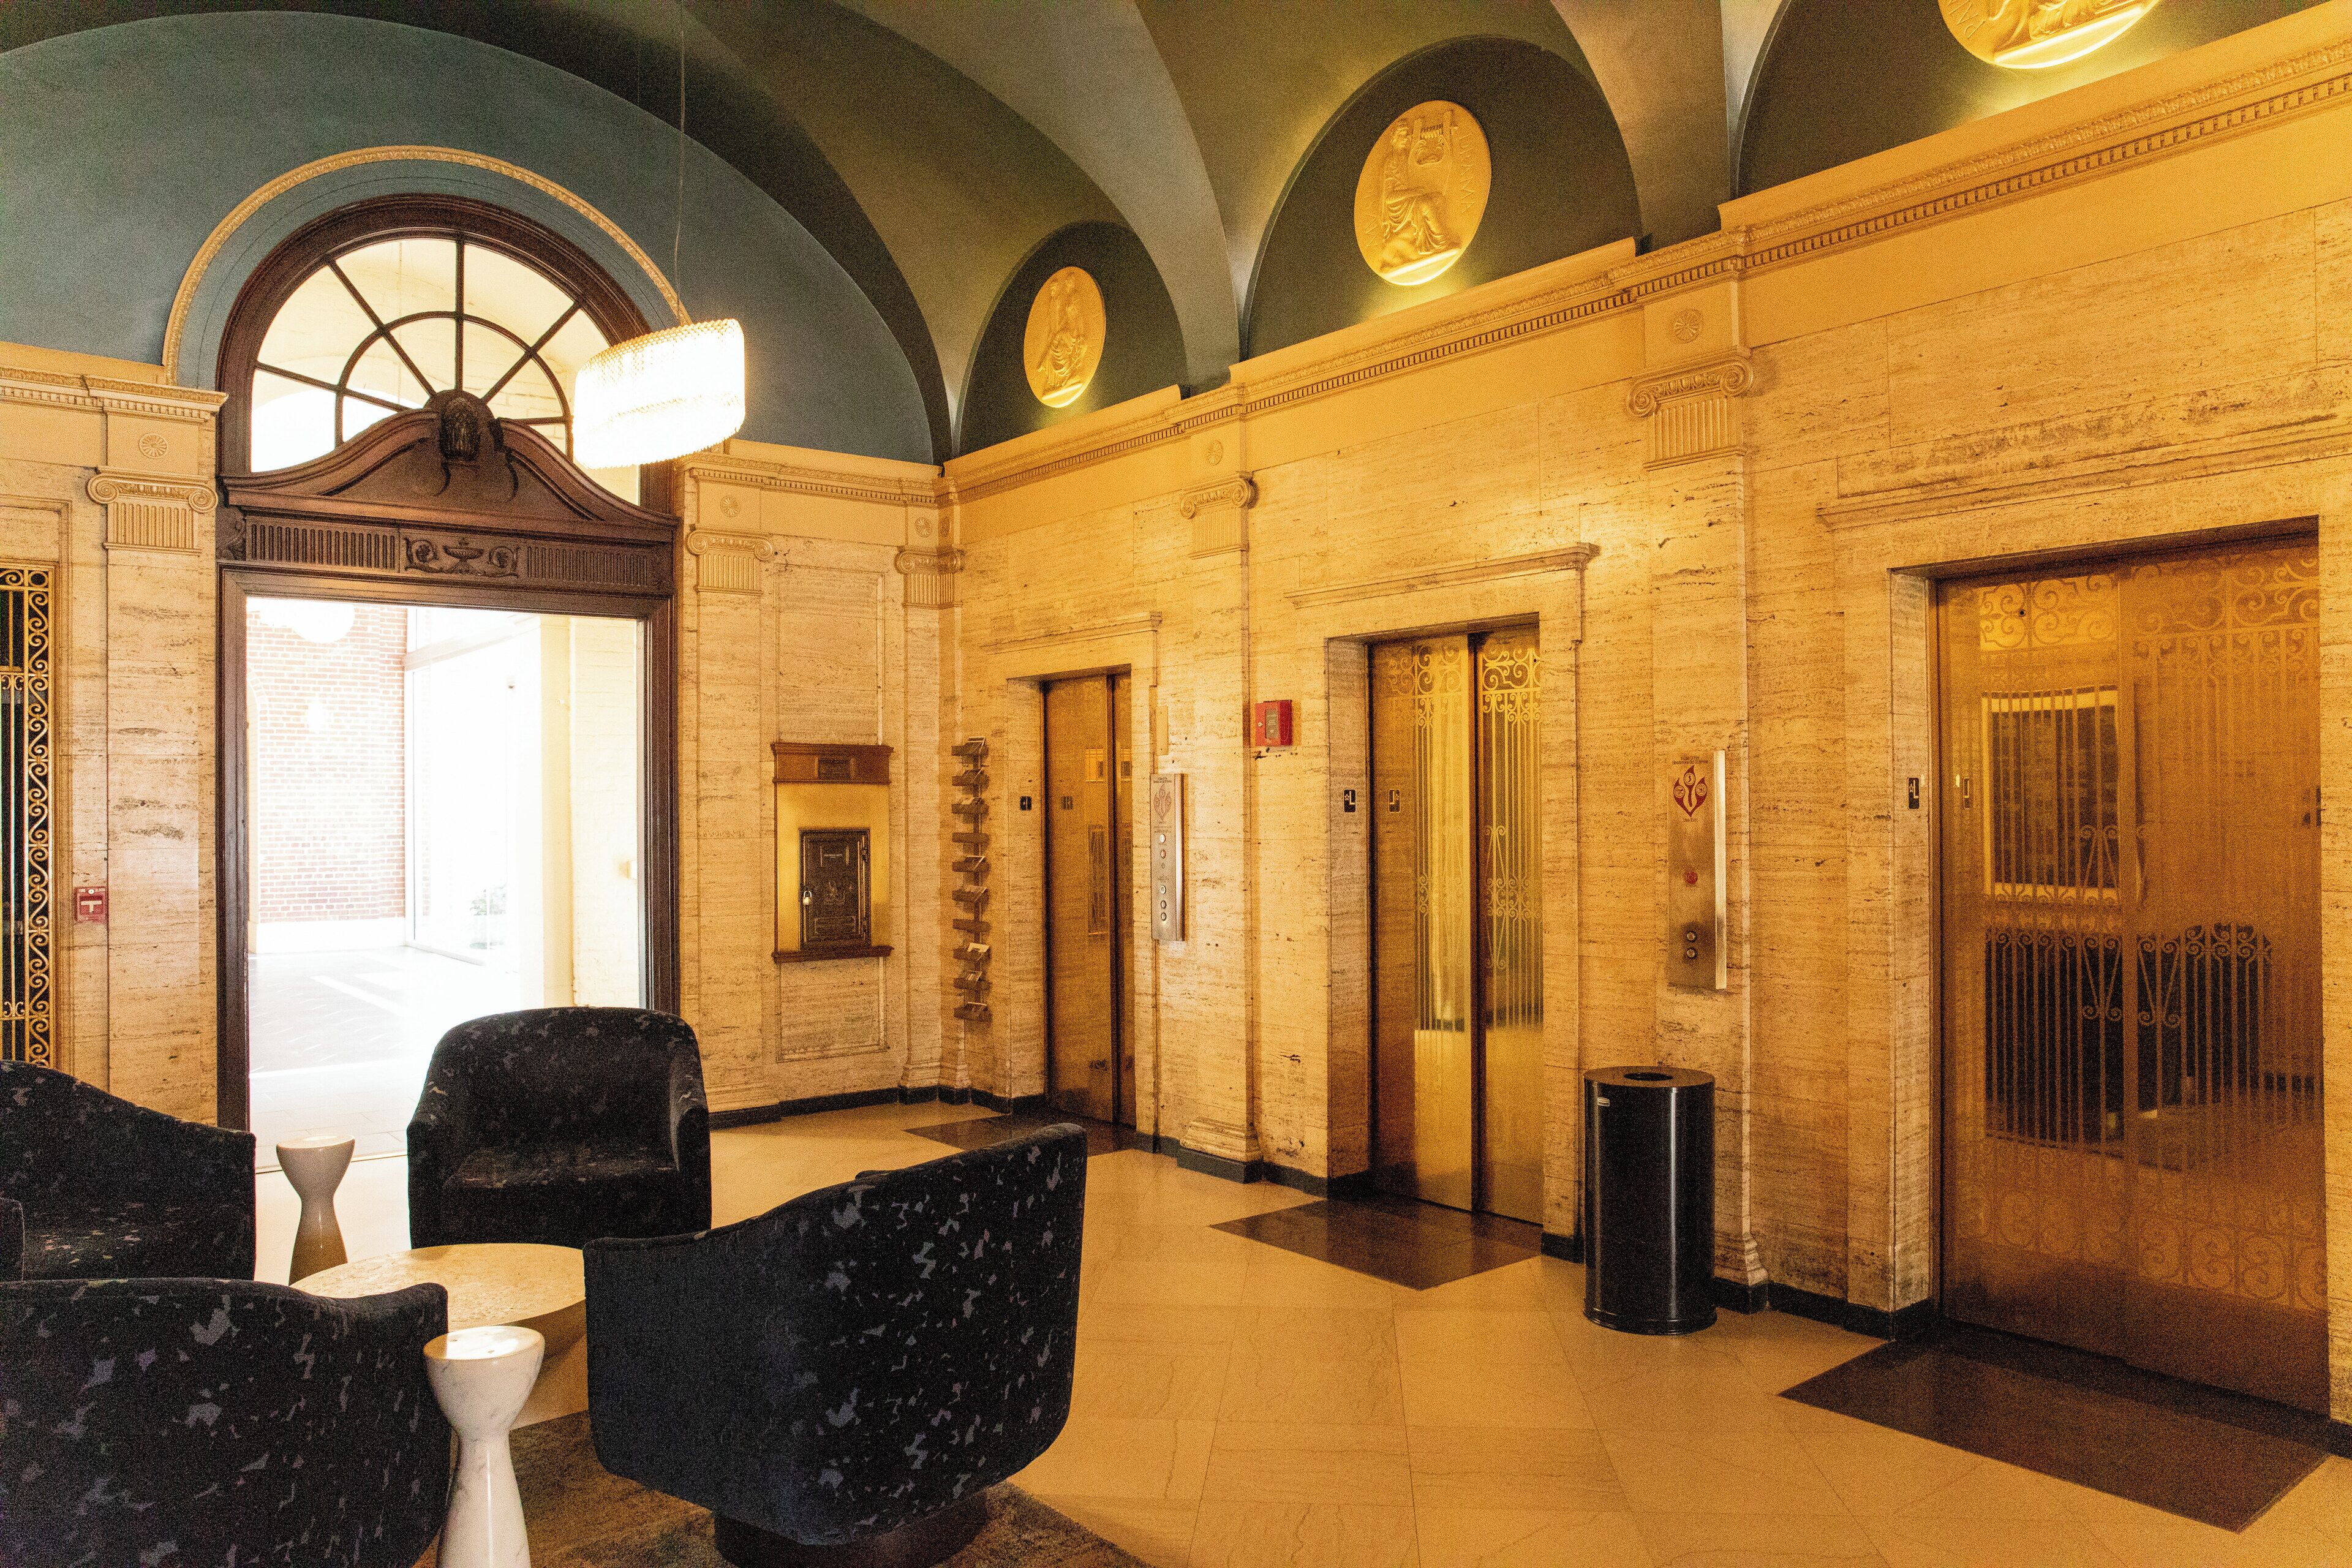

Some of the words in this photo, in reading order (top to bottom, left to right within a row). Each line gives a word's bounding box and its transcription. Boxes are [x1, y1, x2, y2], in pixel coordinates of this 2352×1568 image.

[1948, 0, 1985, 39] PAI
[1459, 134, 1475, 214] DRAMA
[1349, 791, 1355, 805] L
[1913, 780, 1919, 798] L
